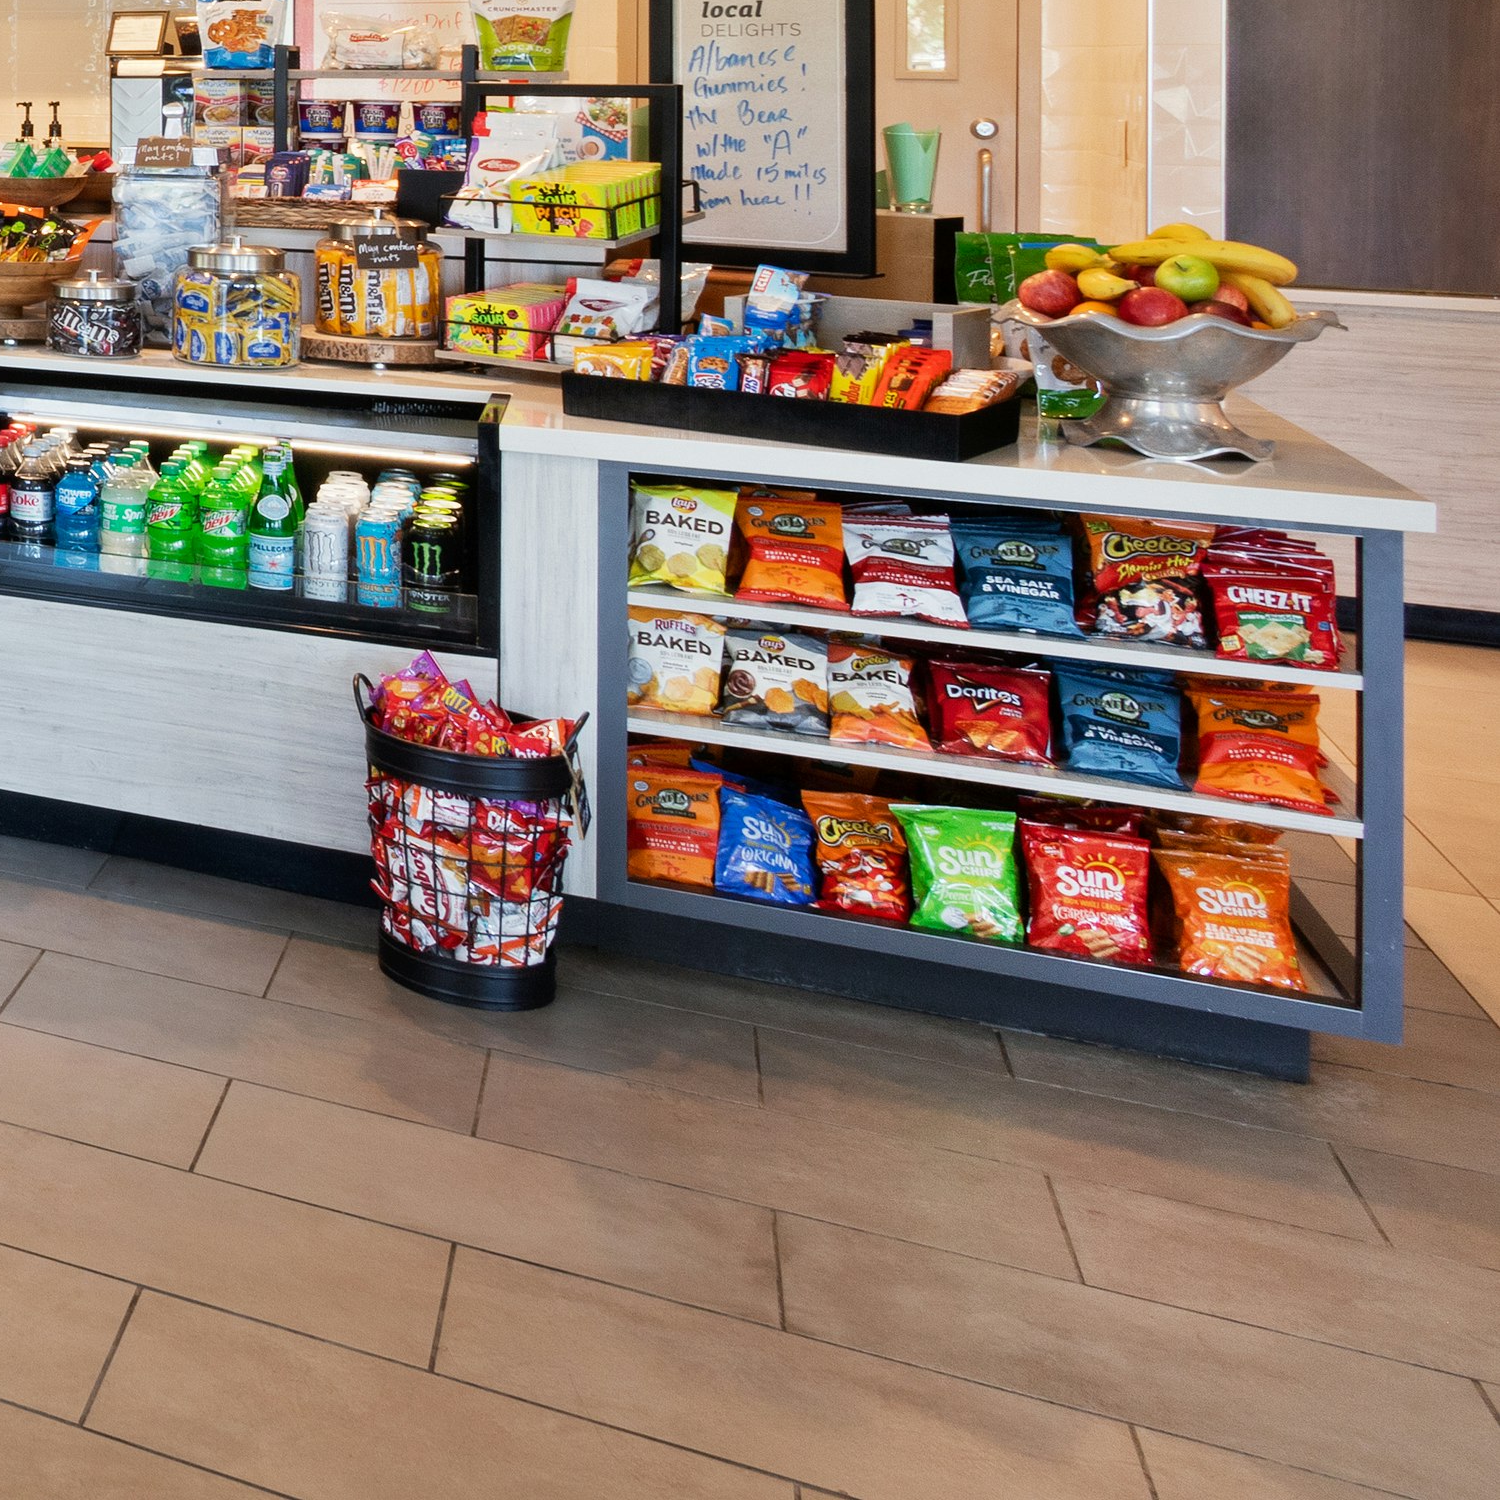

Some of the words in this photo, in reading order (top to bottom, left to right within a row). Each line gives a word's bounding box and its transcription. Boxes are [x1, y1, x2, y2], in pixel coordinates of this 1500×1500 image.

[702, 0, 763, 19] local
[701, 22, 802, 38] DELIGHTS
[493, 44, 553, 55] AVOCADO
[534, 193, 578, 205] SOUR
[699, 188, 732, 211] rom
[471, 313, 505, 325] SOUR
[10, 490, 40, 507] Coke
[645, 510, 724, 535] BAKED
[1103, 534, 1197, 559] Cheetos
[982, 583, 993, 592] &
[996, 584, 1060, 600] VINEGAR
[985, 575, 1015, 584] SEA
[1019, 579, 1054, 590] SALT
[654, 618, 697, 636] RUFFLES
[638, 631, 712, 656] BAKED
[735, 649, 816, 671] BAKED
[441, 687, 473, 715] RITZ
[946, 684, 1022, 707] Doritos
[938, 845, 1003, 876] Sun
[961, 865, 1001, 879] CHIPS
[1055, 864, 1125, 897] Sun
[1080, 886, 1124, 902] CHIPS
[1195, 886, 1268, 915] Sun
[1223, 906, 1268, 919] CHIPS
